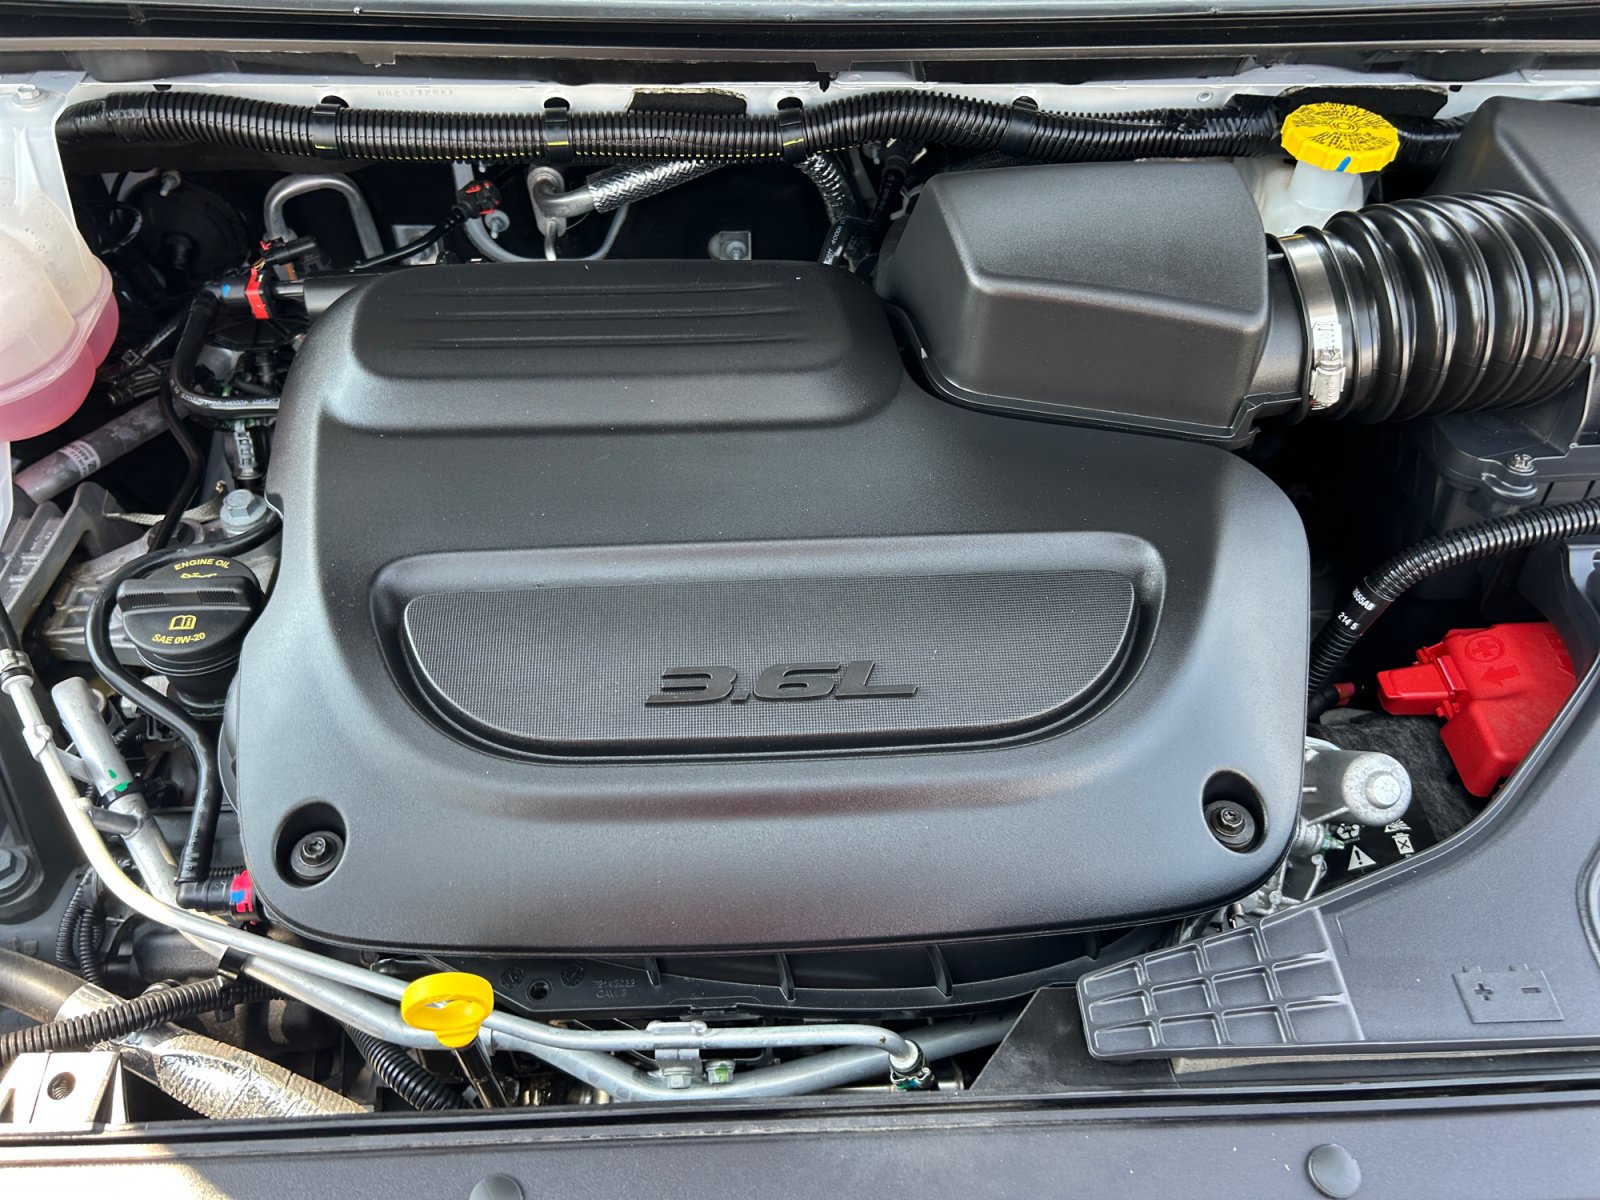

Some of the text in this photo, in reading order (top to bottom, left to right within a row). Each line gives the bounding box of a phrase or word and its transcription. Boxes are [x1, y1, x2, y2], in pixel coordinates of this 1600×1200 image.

[174, 558, 230, 570] ENGINE OIL
[152, 632, 206, 645] SAE 0W-20
[644, 660, 919, 707] 3.6L
